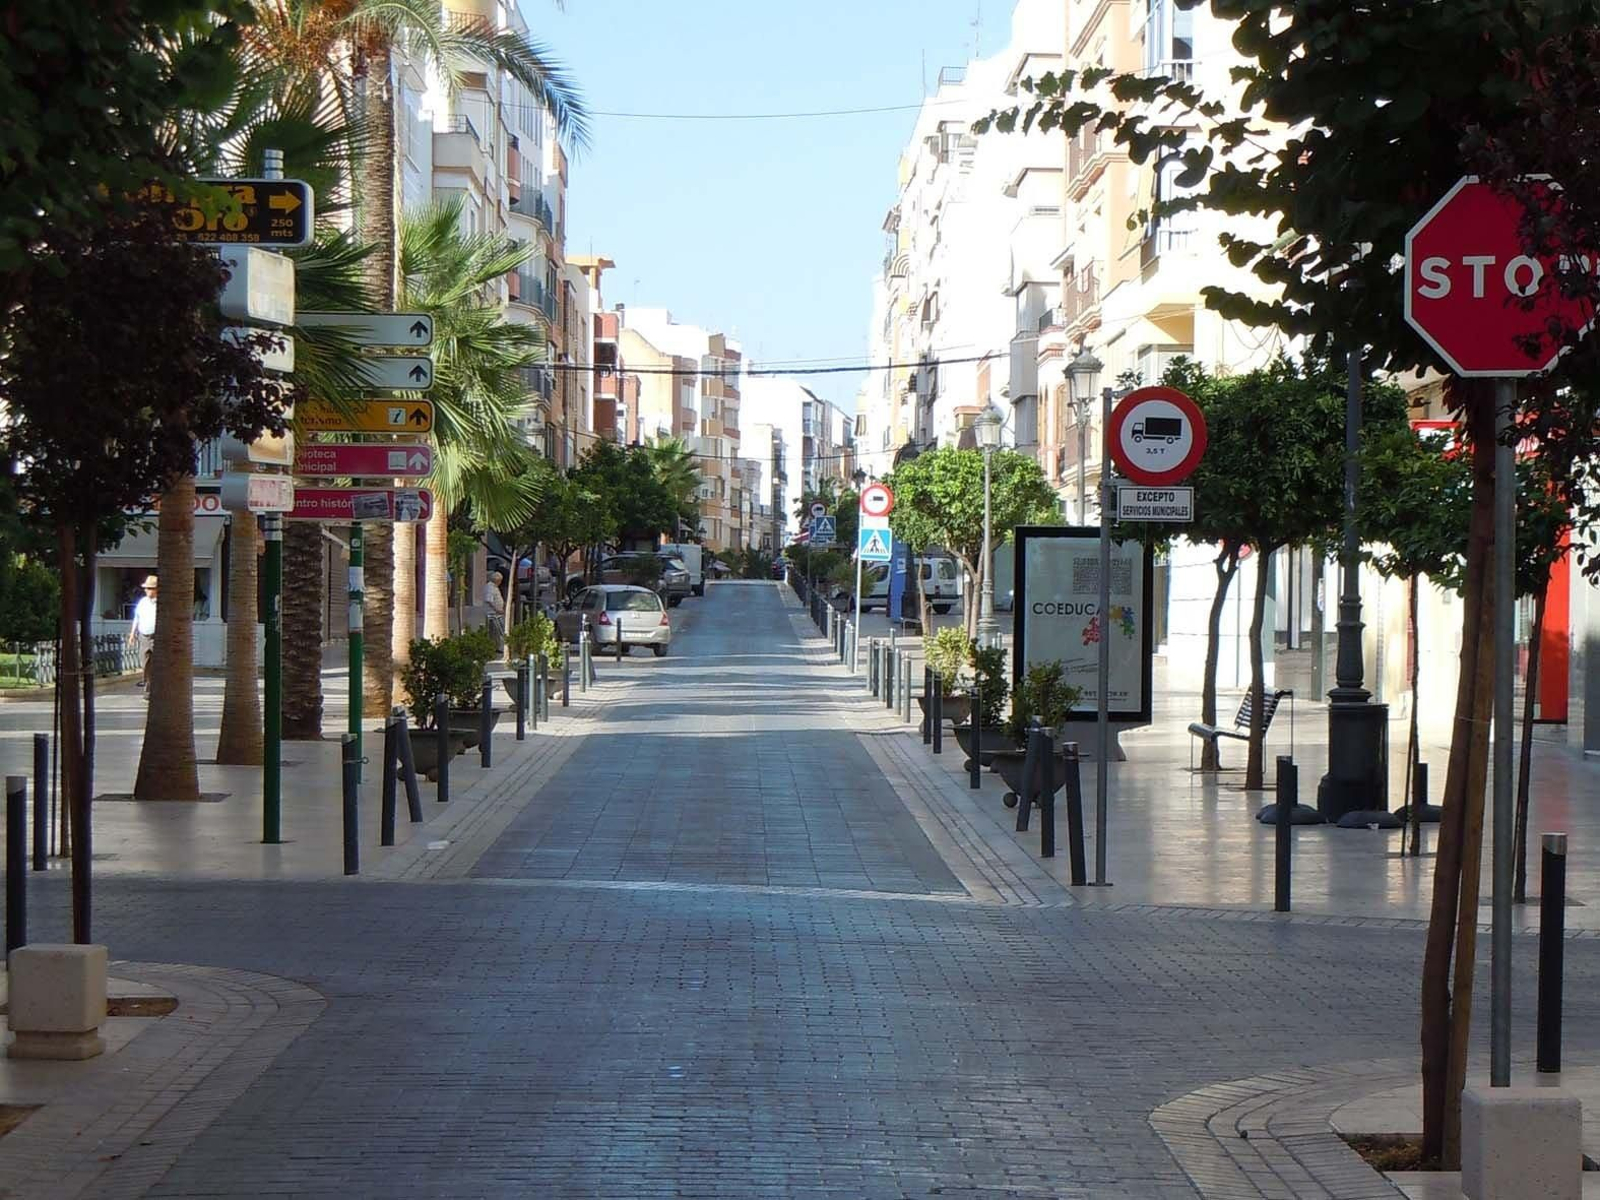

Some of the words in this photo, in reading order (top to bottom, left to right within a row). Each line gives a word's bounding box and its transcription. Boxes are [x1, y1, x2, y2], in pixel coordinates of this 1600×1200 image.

[270, 218, 294, 228] 250
[270, 229, 294, 238] mts
[299, 461, 337, 473] nicipal
[295, 498, 318, 508] ntro
[320, 496, 354, 508] histór
[1137, 491, 1175, 502] EXCEPTO
[1122, 505, 1151, 517] SERVICIOS
[1152, 506, 1188, 517] MUNICIPALES
[1032, 602, 1101, 616] COEDUC
